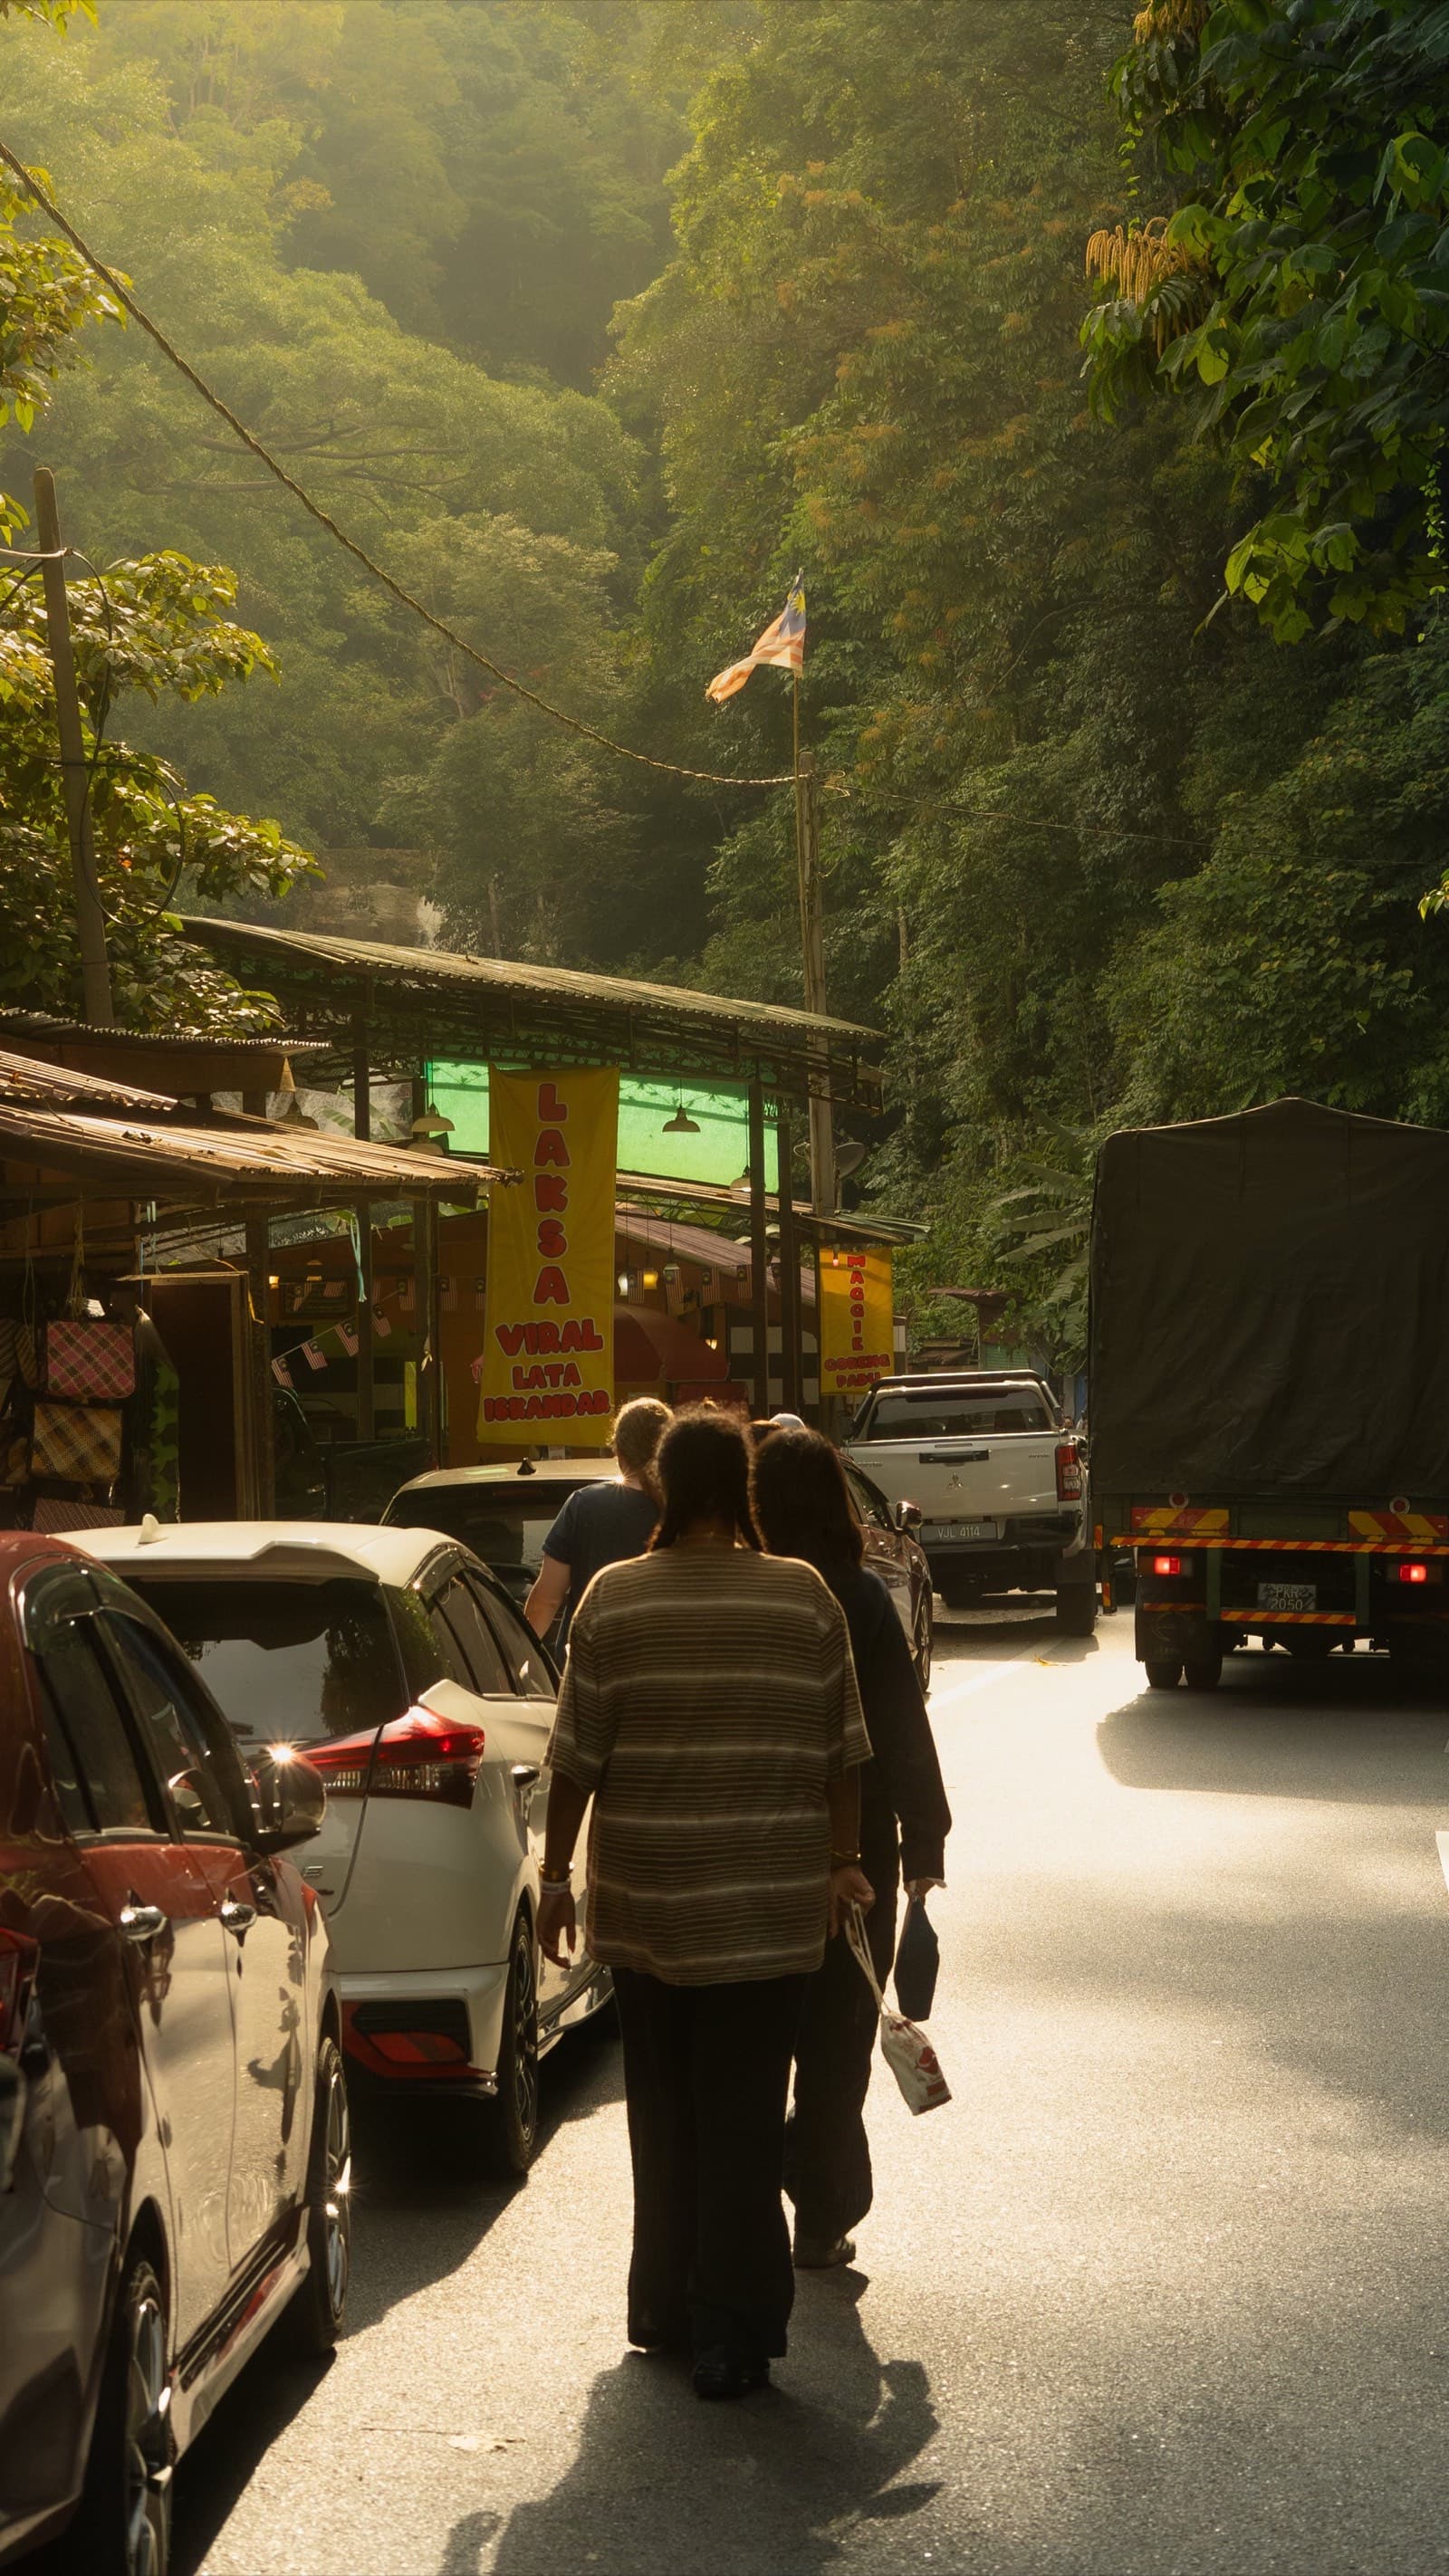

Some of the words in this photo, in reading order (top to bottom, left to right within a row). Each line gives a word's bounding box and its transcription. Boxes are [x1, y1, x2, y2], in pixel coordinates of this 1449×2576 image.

[533, 1082, 571, 1305] LAKSA
[847, 1255, 866, 1352] MAGGIE
[495, 1318, 604, 1356] VIRAL
[512, 1363, 581, 1390] LATA
[824, 1354, 891, 1372] GORENG
[836, 1372, 882, 1388] PADU
[483, 1390, 611, 1422] ISKANDAR
[937, 1527, 956, 1538] VJL
[959, 1526, 980, 1537] 4114
